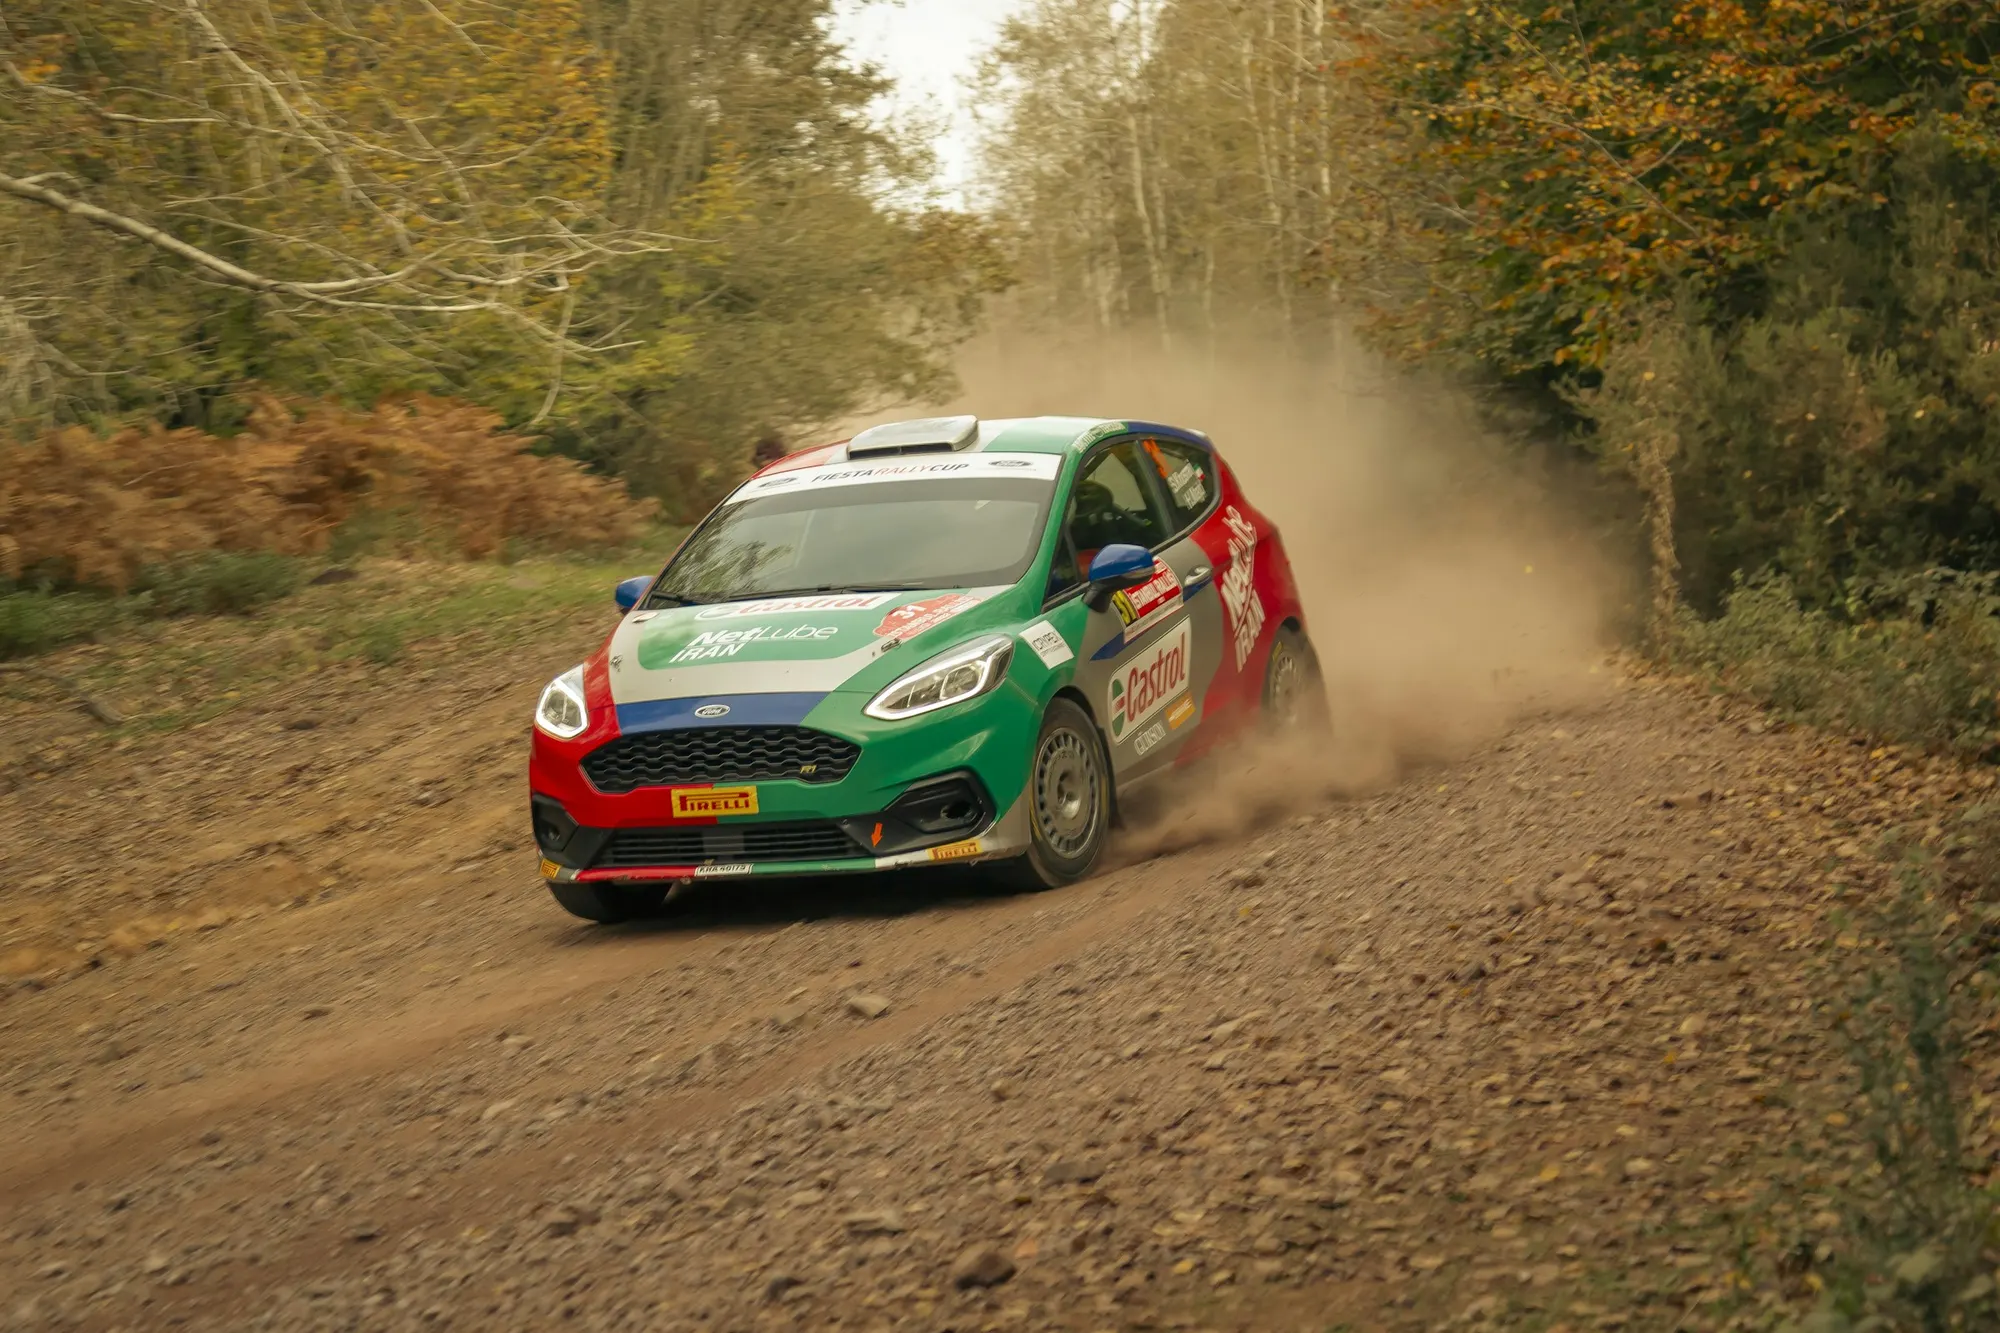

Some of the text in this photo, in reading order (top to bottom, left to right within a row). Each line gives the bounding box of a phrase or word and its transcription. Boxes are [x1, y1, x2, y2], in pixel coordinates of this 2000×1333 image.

[739, 596, 885, 614] Castrol
[686, 624, 838, 648] NetLube
[668, 642, 746, 664] IRAN
[1126, 632, 1187, 722] Castrol
[679, 792, 750, 812] PIRELLI
[932, 842, 977, 860] PIRELLI
